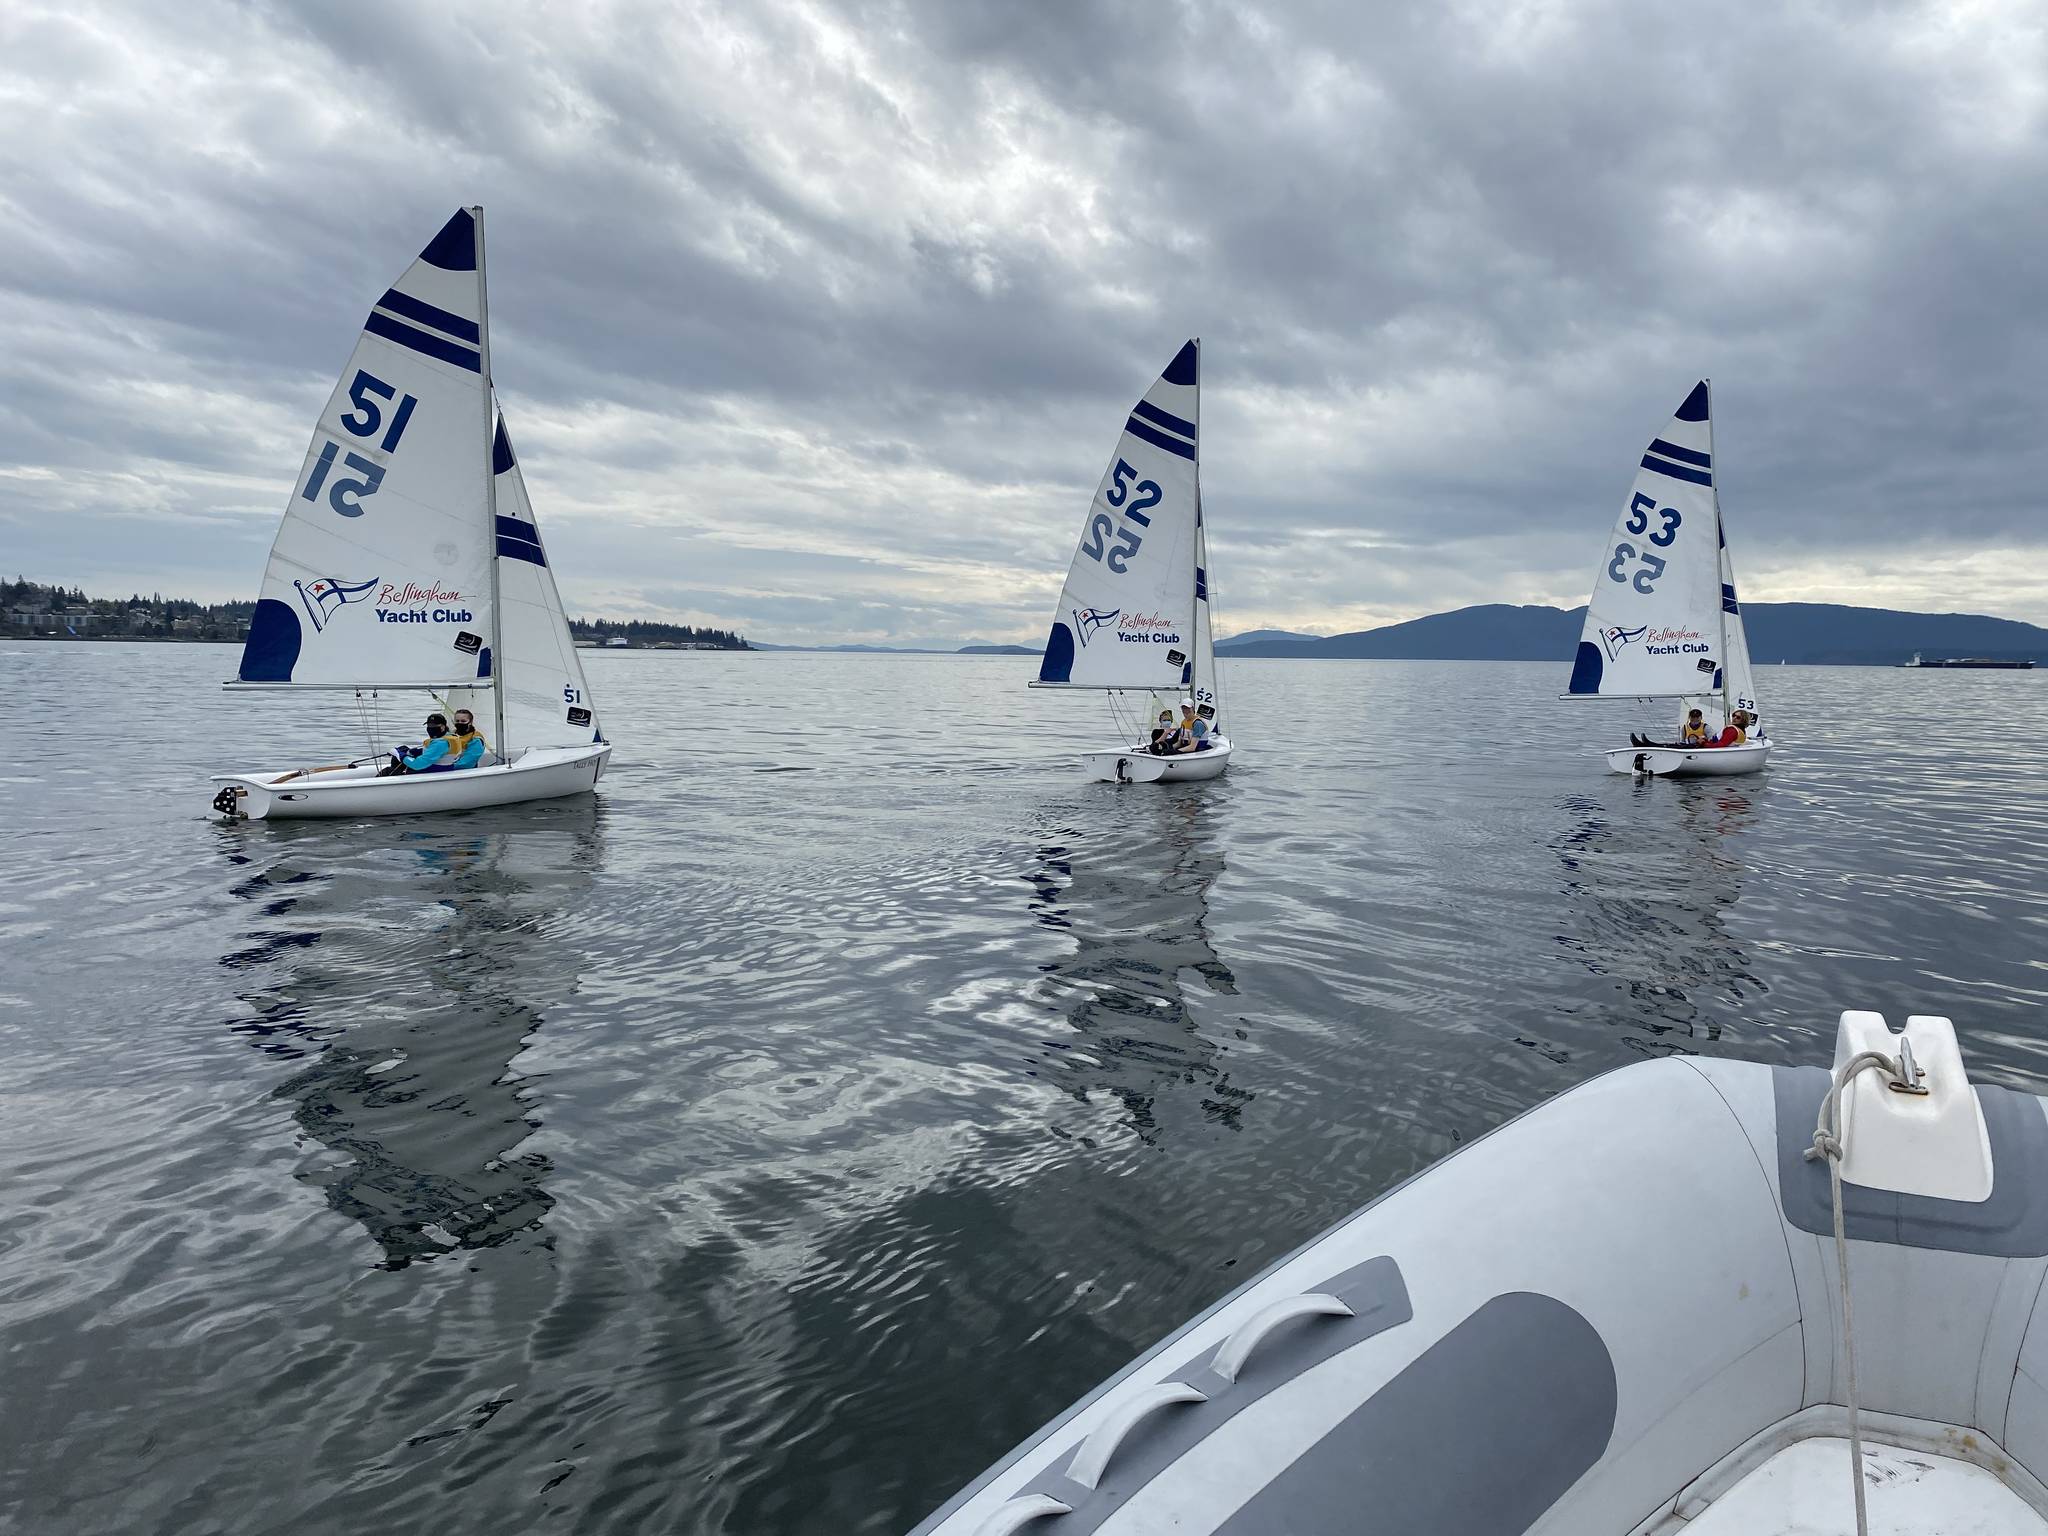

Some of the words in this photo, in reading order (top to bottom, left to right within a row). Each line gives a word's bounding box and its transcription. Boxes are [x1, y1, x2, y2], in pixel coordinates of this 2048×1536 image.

[340, 368, 419, 454] 51
[1106, 457, 1163, 528] 52
[1625, 491, 1682, 547] 53
[376, 579, 476, 612] Bellingham
[375, 608, 428, 623] Yacht
[432, 608, 473, 623] Club
[1118, 610, 1184, 635] Bellingham
[1117, 631, 1150, 643] Yacht
[1152, 632, 1180, 643] Club
[1646, 624, 1711, 645] Bellingham
[1645, 644, 1680, 655] Yacht
[1682, 642, 1709, 653] Club
[563, 688, 580, 703] 51
[1196, 690, 1213, 703] 52
[1738, 698, 1754, 710] 53
